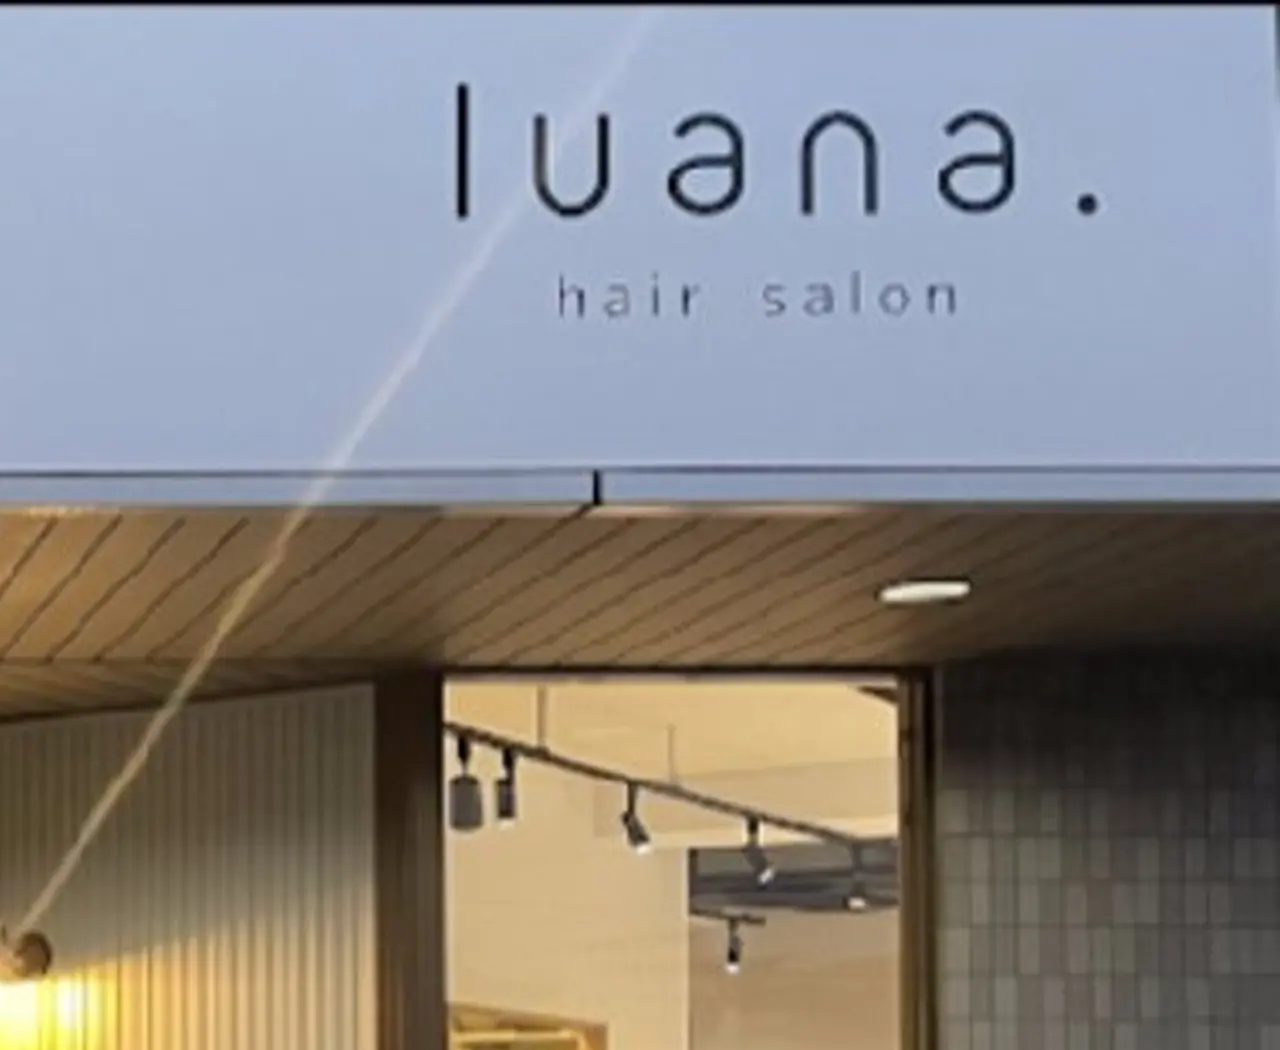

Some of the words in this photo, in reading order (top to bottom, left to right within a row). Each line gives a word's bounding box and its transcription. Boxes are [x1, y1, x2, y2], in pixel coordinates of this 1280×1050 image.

[455, 82, 1099, 221] luana.
[557, 271, 701, 319] hair
[762, 270, 958, 319] salon
